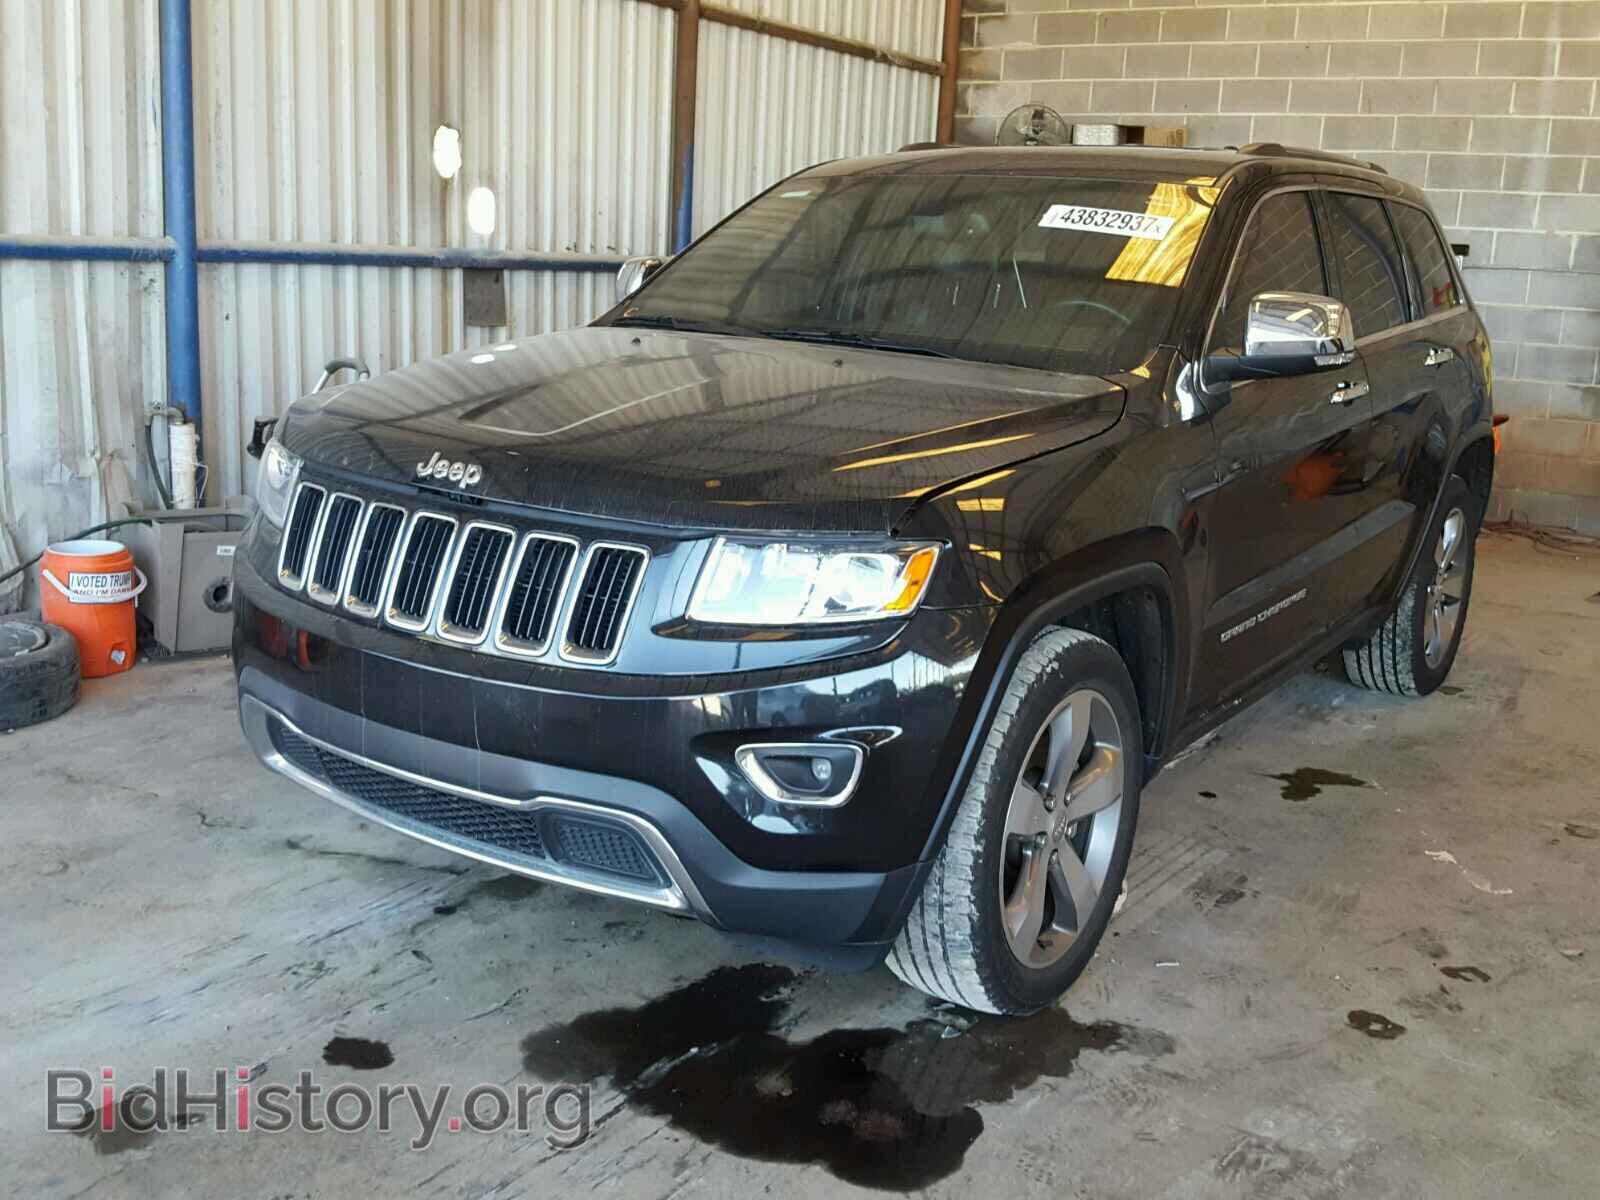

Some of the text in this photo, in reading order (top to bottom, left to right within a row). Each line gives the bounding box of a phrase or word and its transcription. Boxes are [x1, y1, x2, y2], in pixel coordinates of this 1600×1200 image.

[1060, 207, 1159, 233] 43832937
[416, 451, 482, 489] Jeep
[76, 575, 107, 588] VOTED
